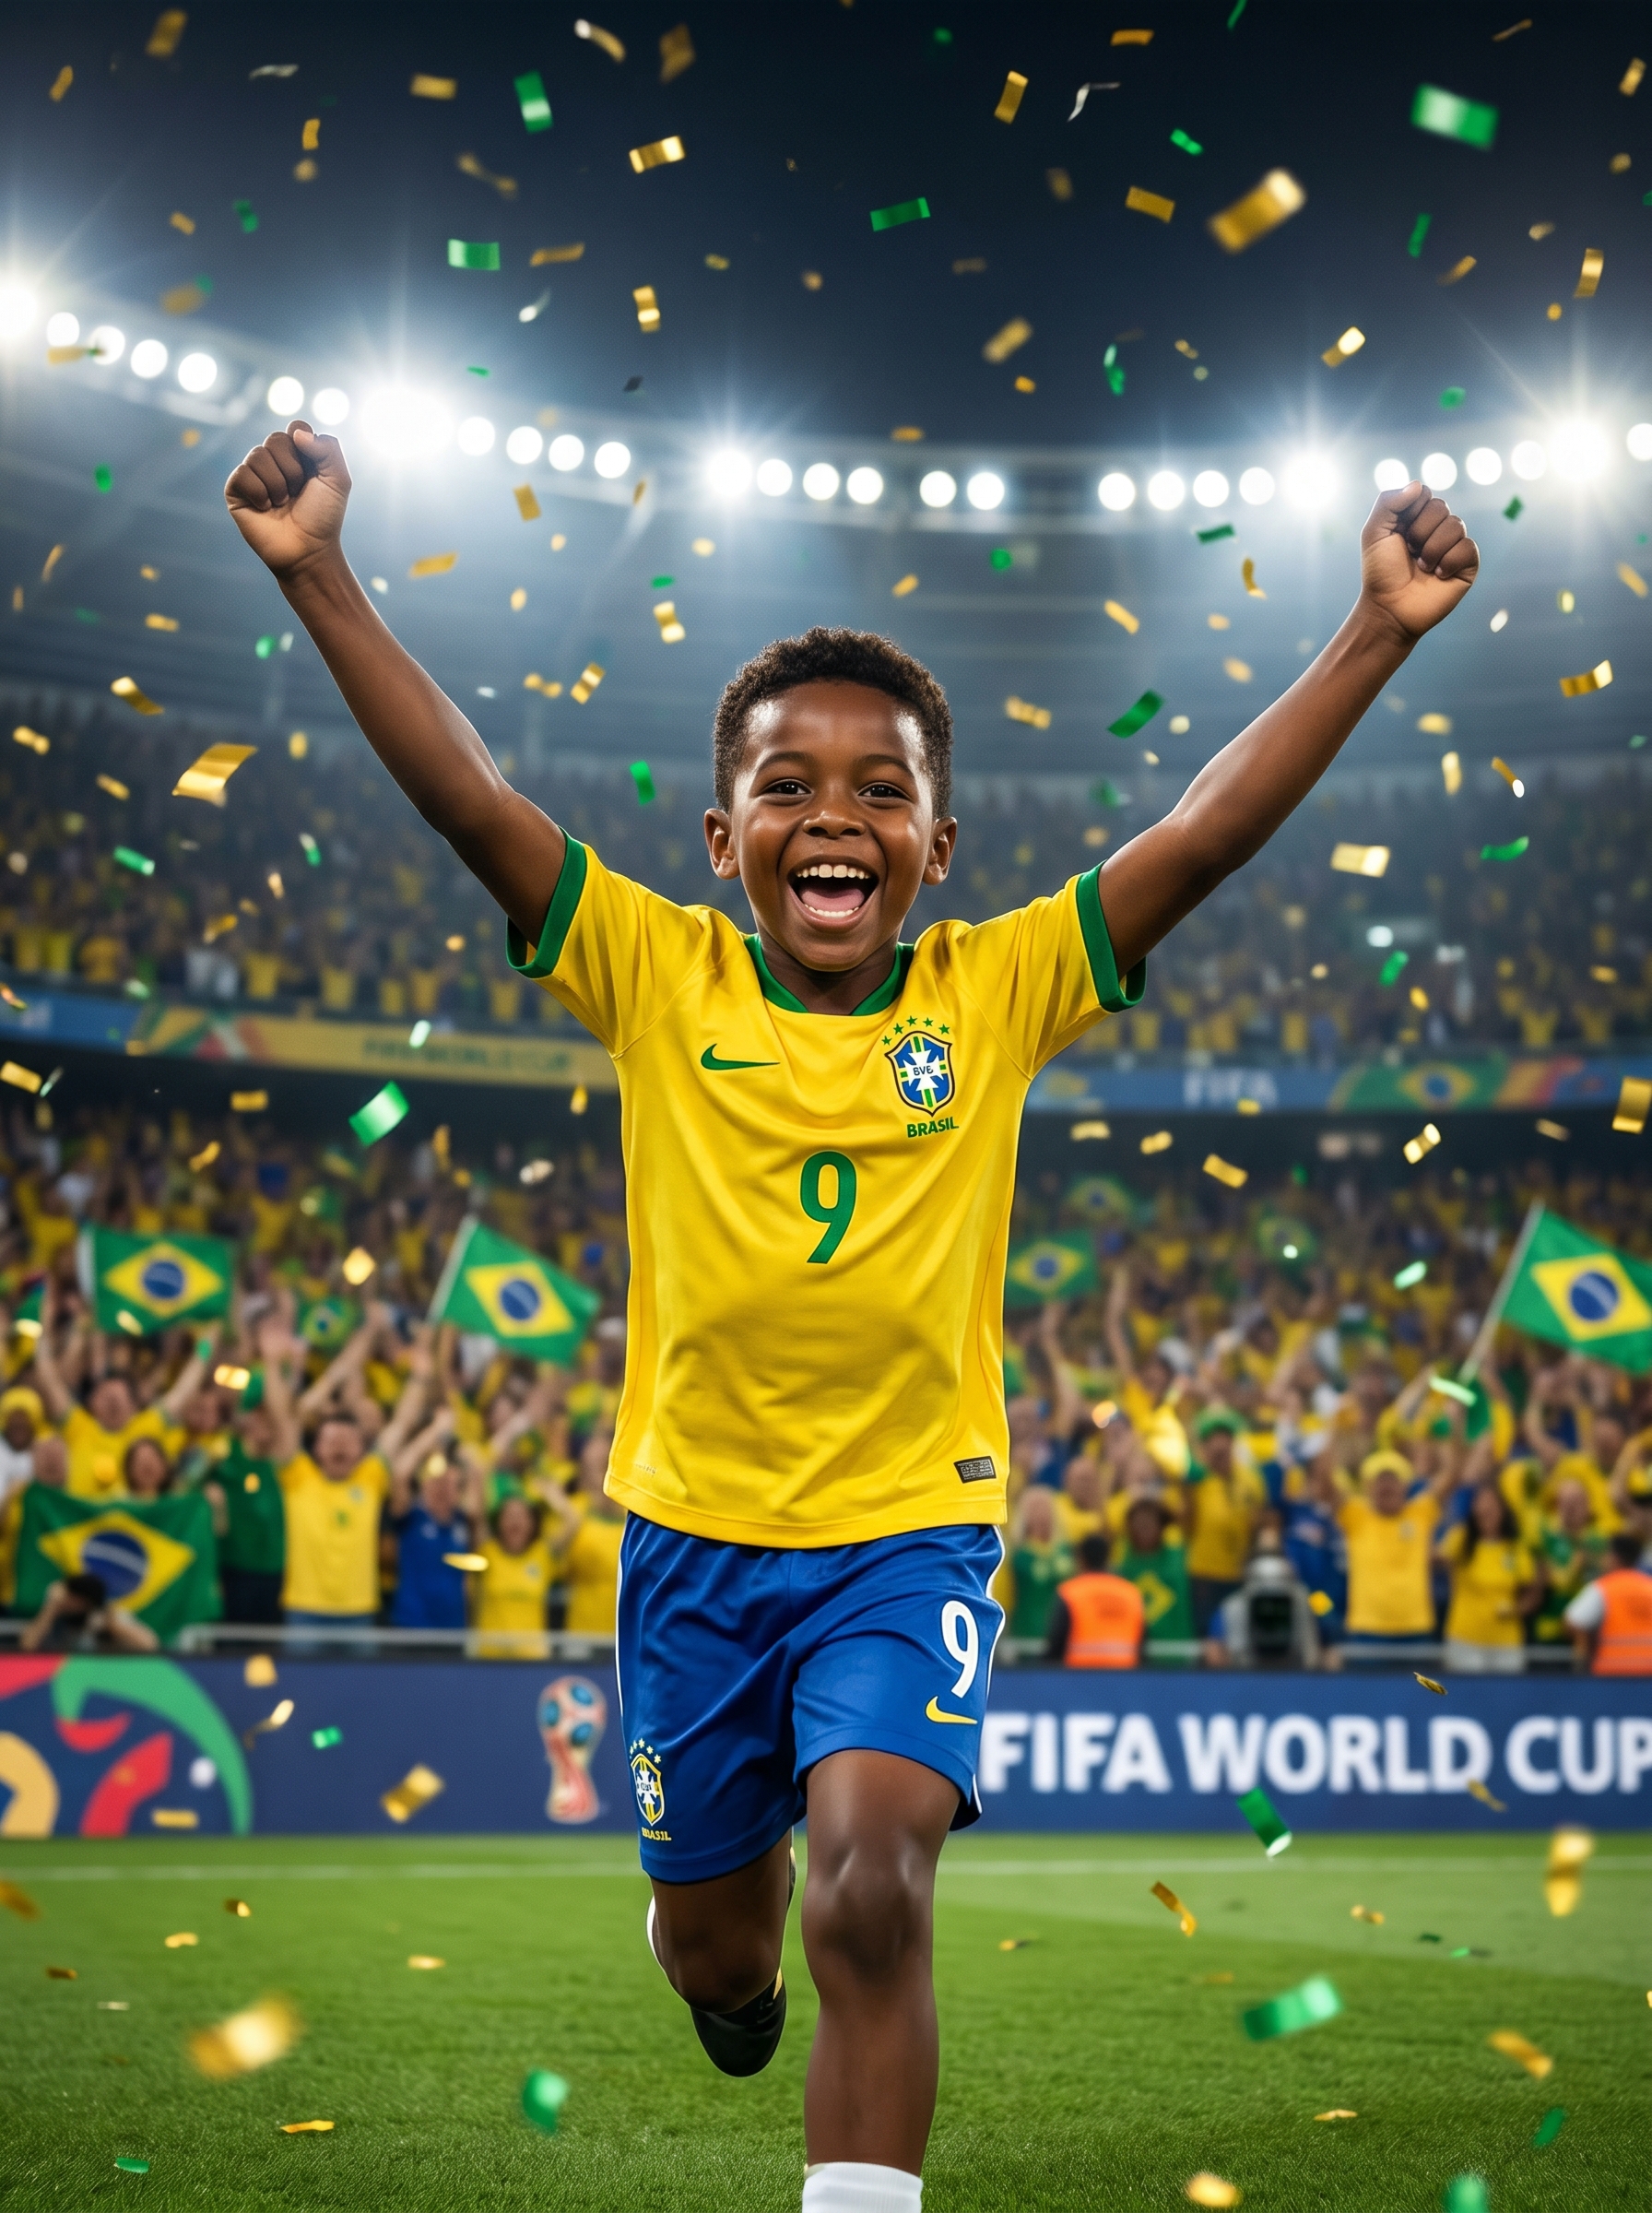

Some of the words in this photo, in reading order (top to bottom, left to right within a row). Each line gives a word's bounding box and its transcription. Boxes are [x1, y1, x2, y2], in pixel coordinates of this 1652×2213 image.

[906, 1117, 959, 1138] BRASIL
[800, 1151, 857, 1264] 9
[941, 1600, 978, 1698] 9
[979, 1712, 1172, 1793] FIFA
[1177, 1713, 1493, 1793] WORLD
[1505, 1716, 1652, 1793] CUP
